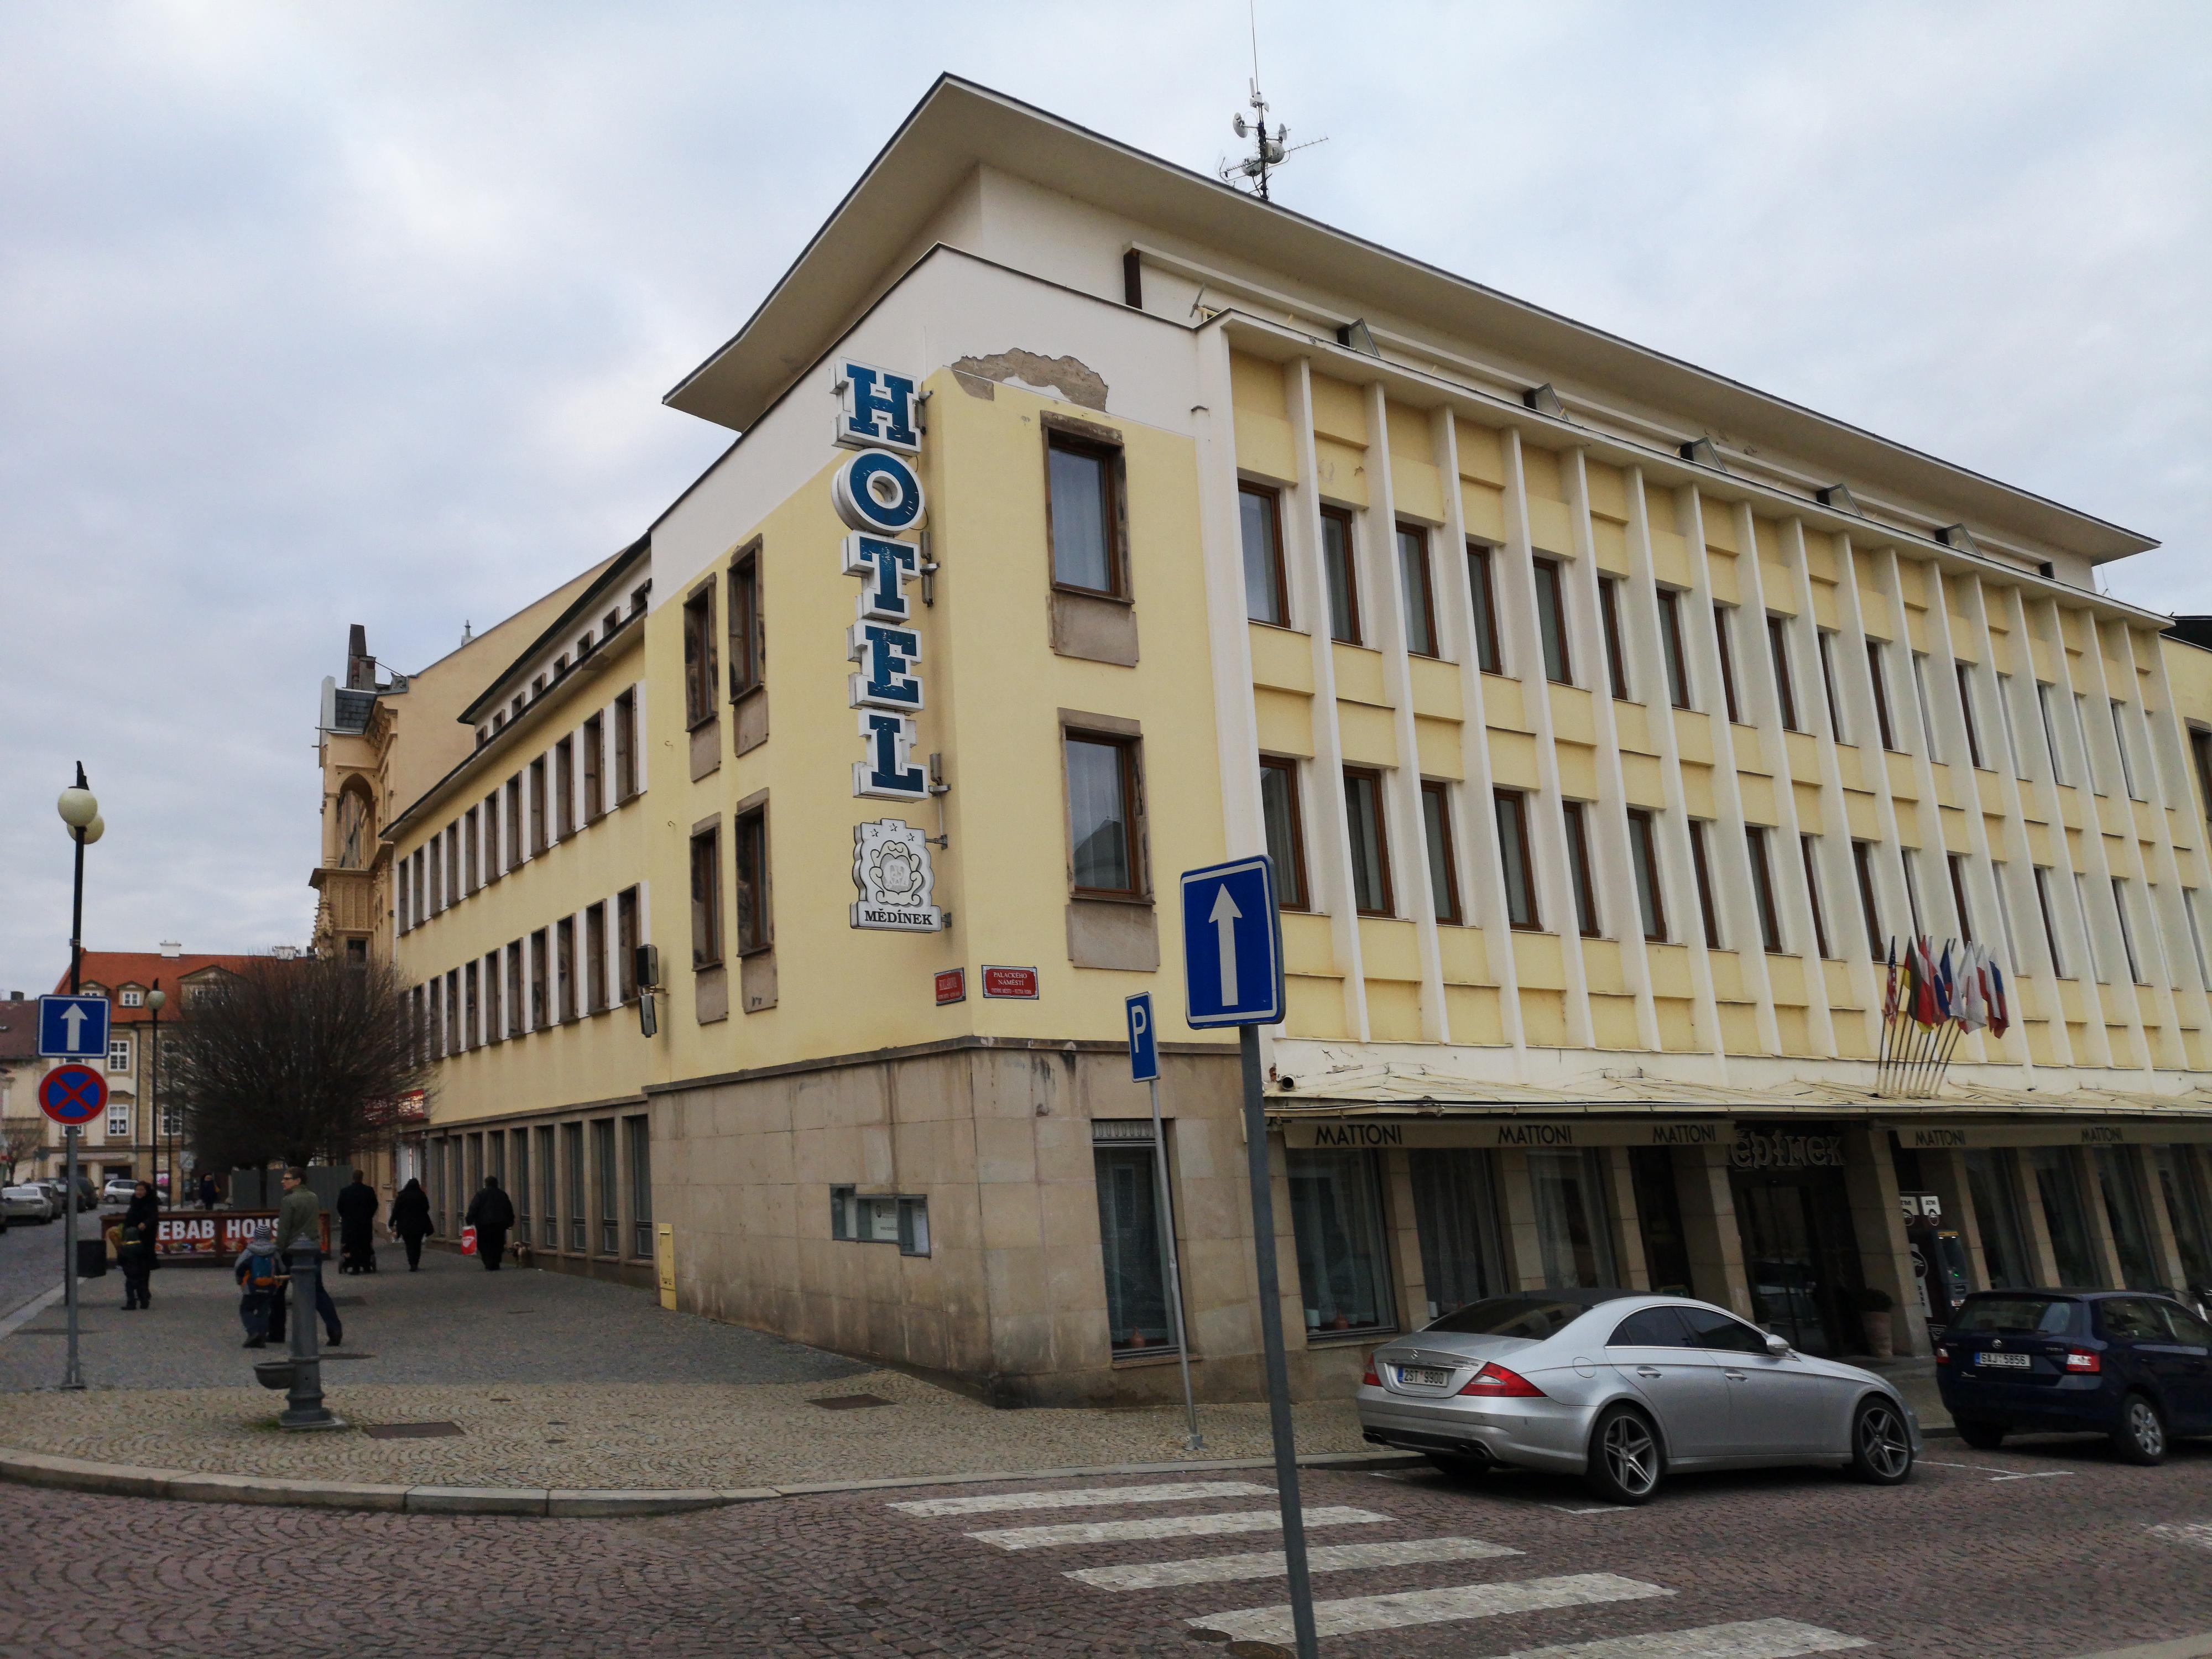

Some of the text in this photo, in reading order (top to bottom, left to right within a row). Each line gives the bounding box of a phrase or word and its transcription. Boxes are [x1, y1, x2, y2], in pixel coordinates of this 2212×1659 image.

[844, 361, 926, 795] HOTEL
[864, 908, 933, 925] MĚDÍNEK
[1131, 1005, 1146, 1053] P
[1315, 1124, 1402, 1145] MATTONI
[1498, 1125, 1572, 1145] MATTONI
[1652, 1125, 1717, 1143] MATTONI
[1915, 1129, 1966, 1146] MATTONI
[2081, 1127, 2124, 1142] MATTONI
[158, 1219, 216, 1240] EBAB
[1404, 1368, 1418, 1383] 2ST
